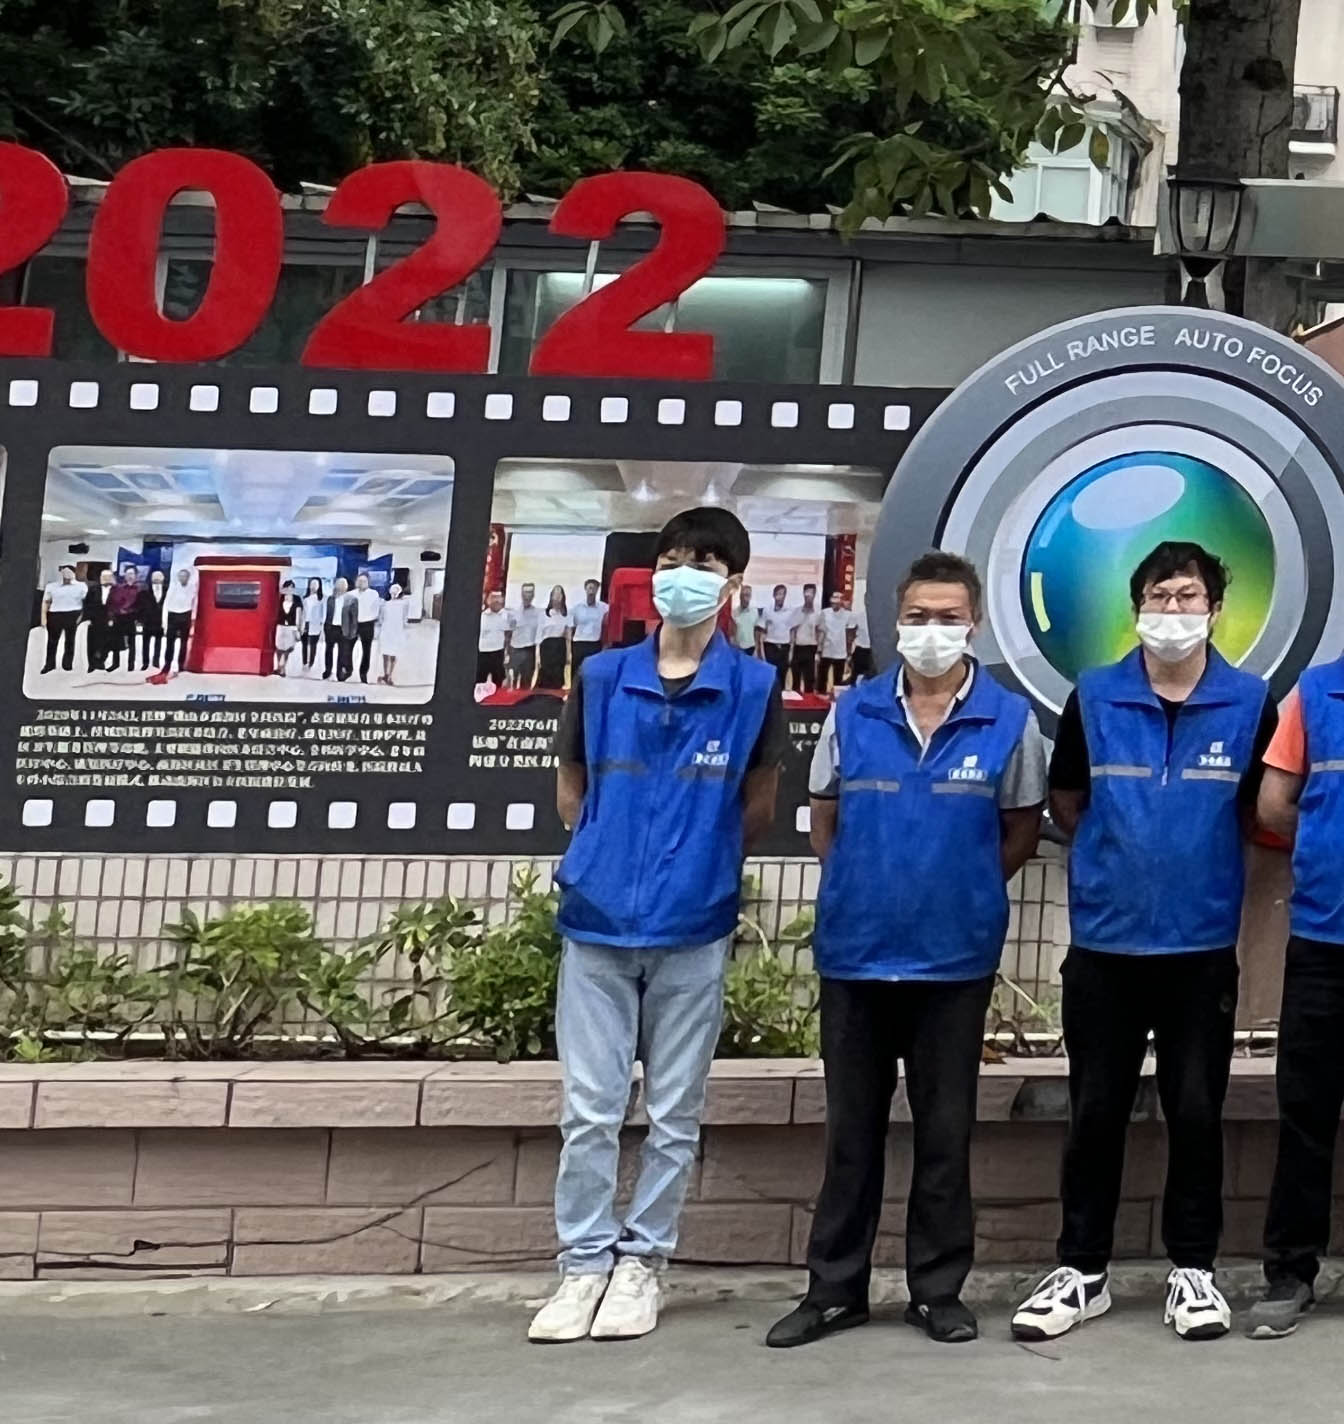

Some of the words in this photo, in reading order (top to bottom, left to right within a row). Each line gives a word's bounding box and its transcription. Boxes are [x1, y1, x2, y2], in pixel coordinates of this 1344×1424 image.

[1005, 353, 1064, 395] FULL
[1067, 325, 1155, 361] RANGE
[1175, 328, 1243, 358] AUTO
[1246, 347, 1323, 407] FOCUS
